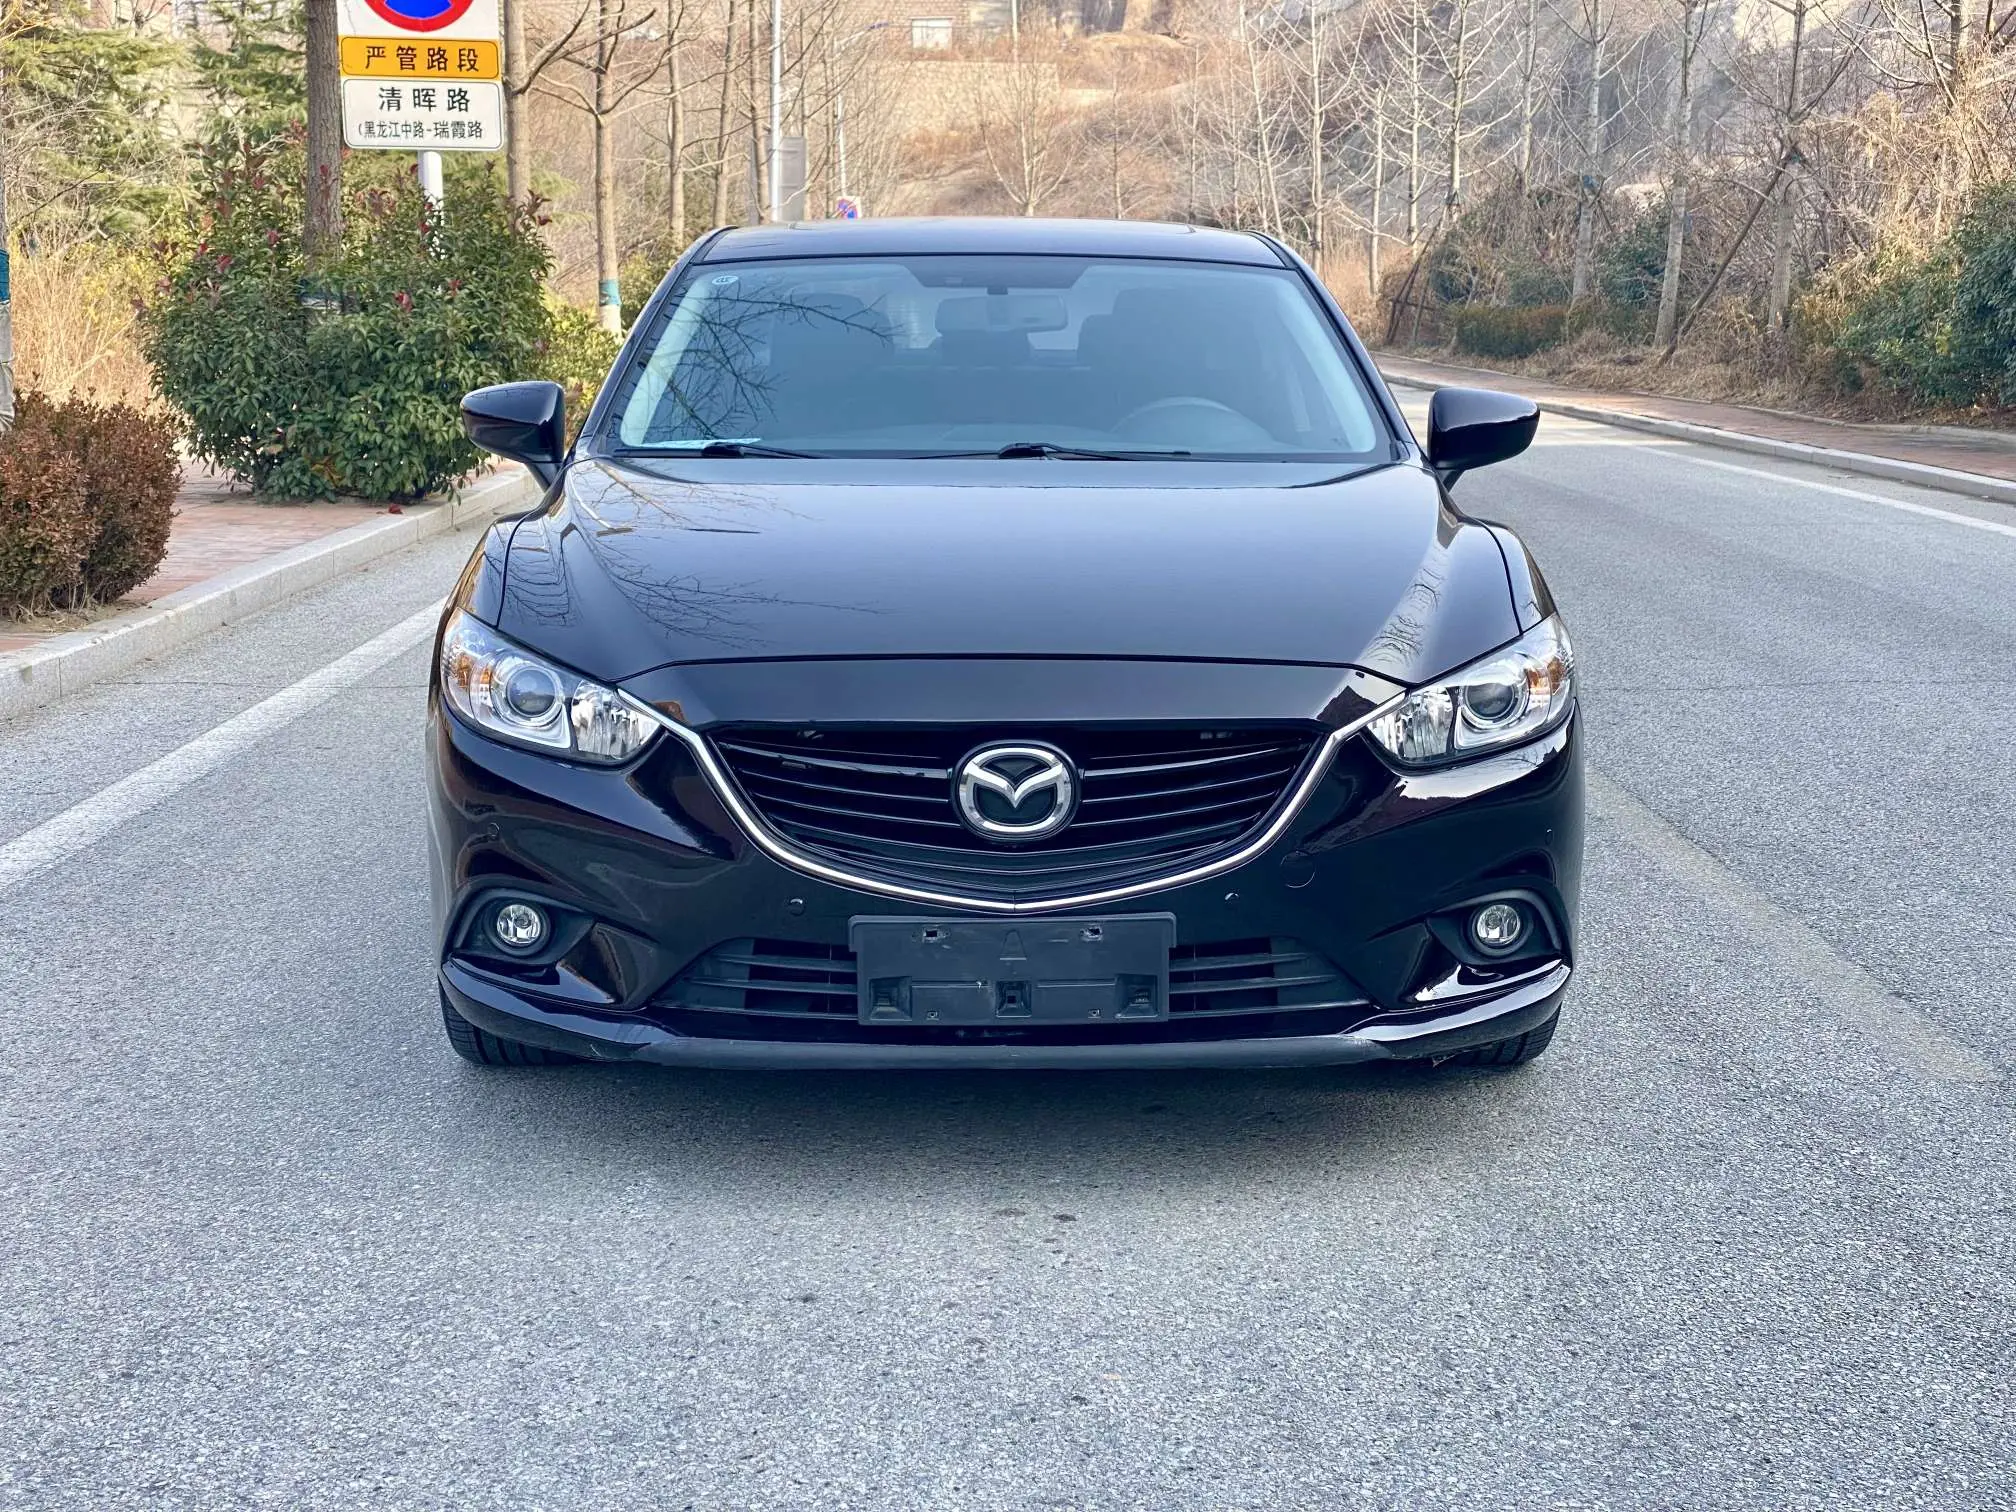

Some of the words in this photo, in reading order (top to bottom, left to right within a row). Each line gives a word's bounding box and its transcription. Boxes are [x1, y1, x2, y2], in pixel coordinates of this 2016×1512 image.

[365, 46, 479, 72] 严管路段
[378, 87, 471, 112] 清晖路
